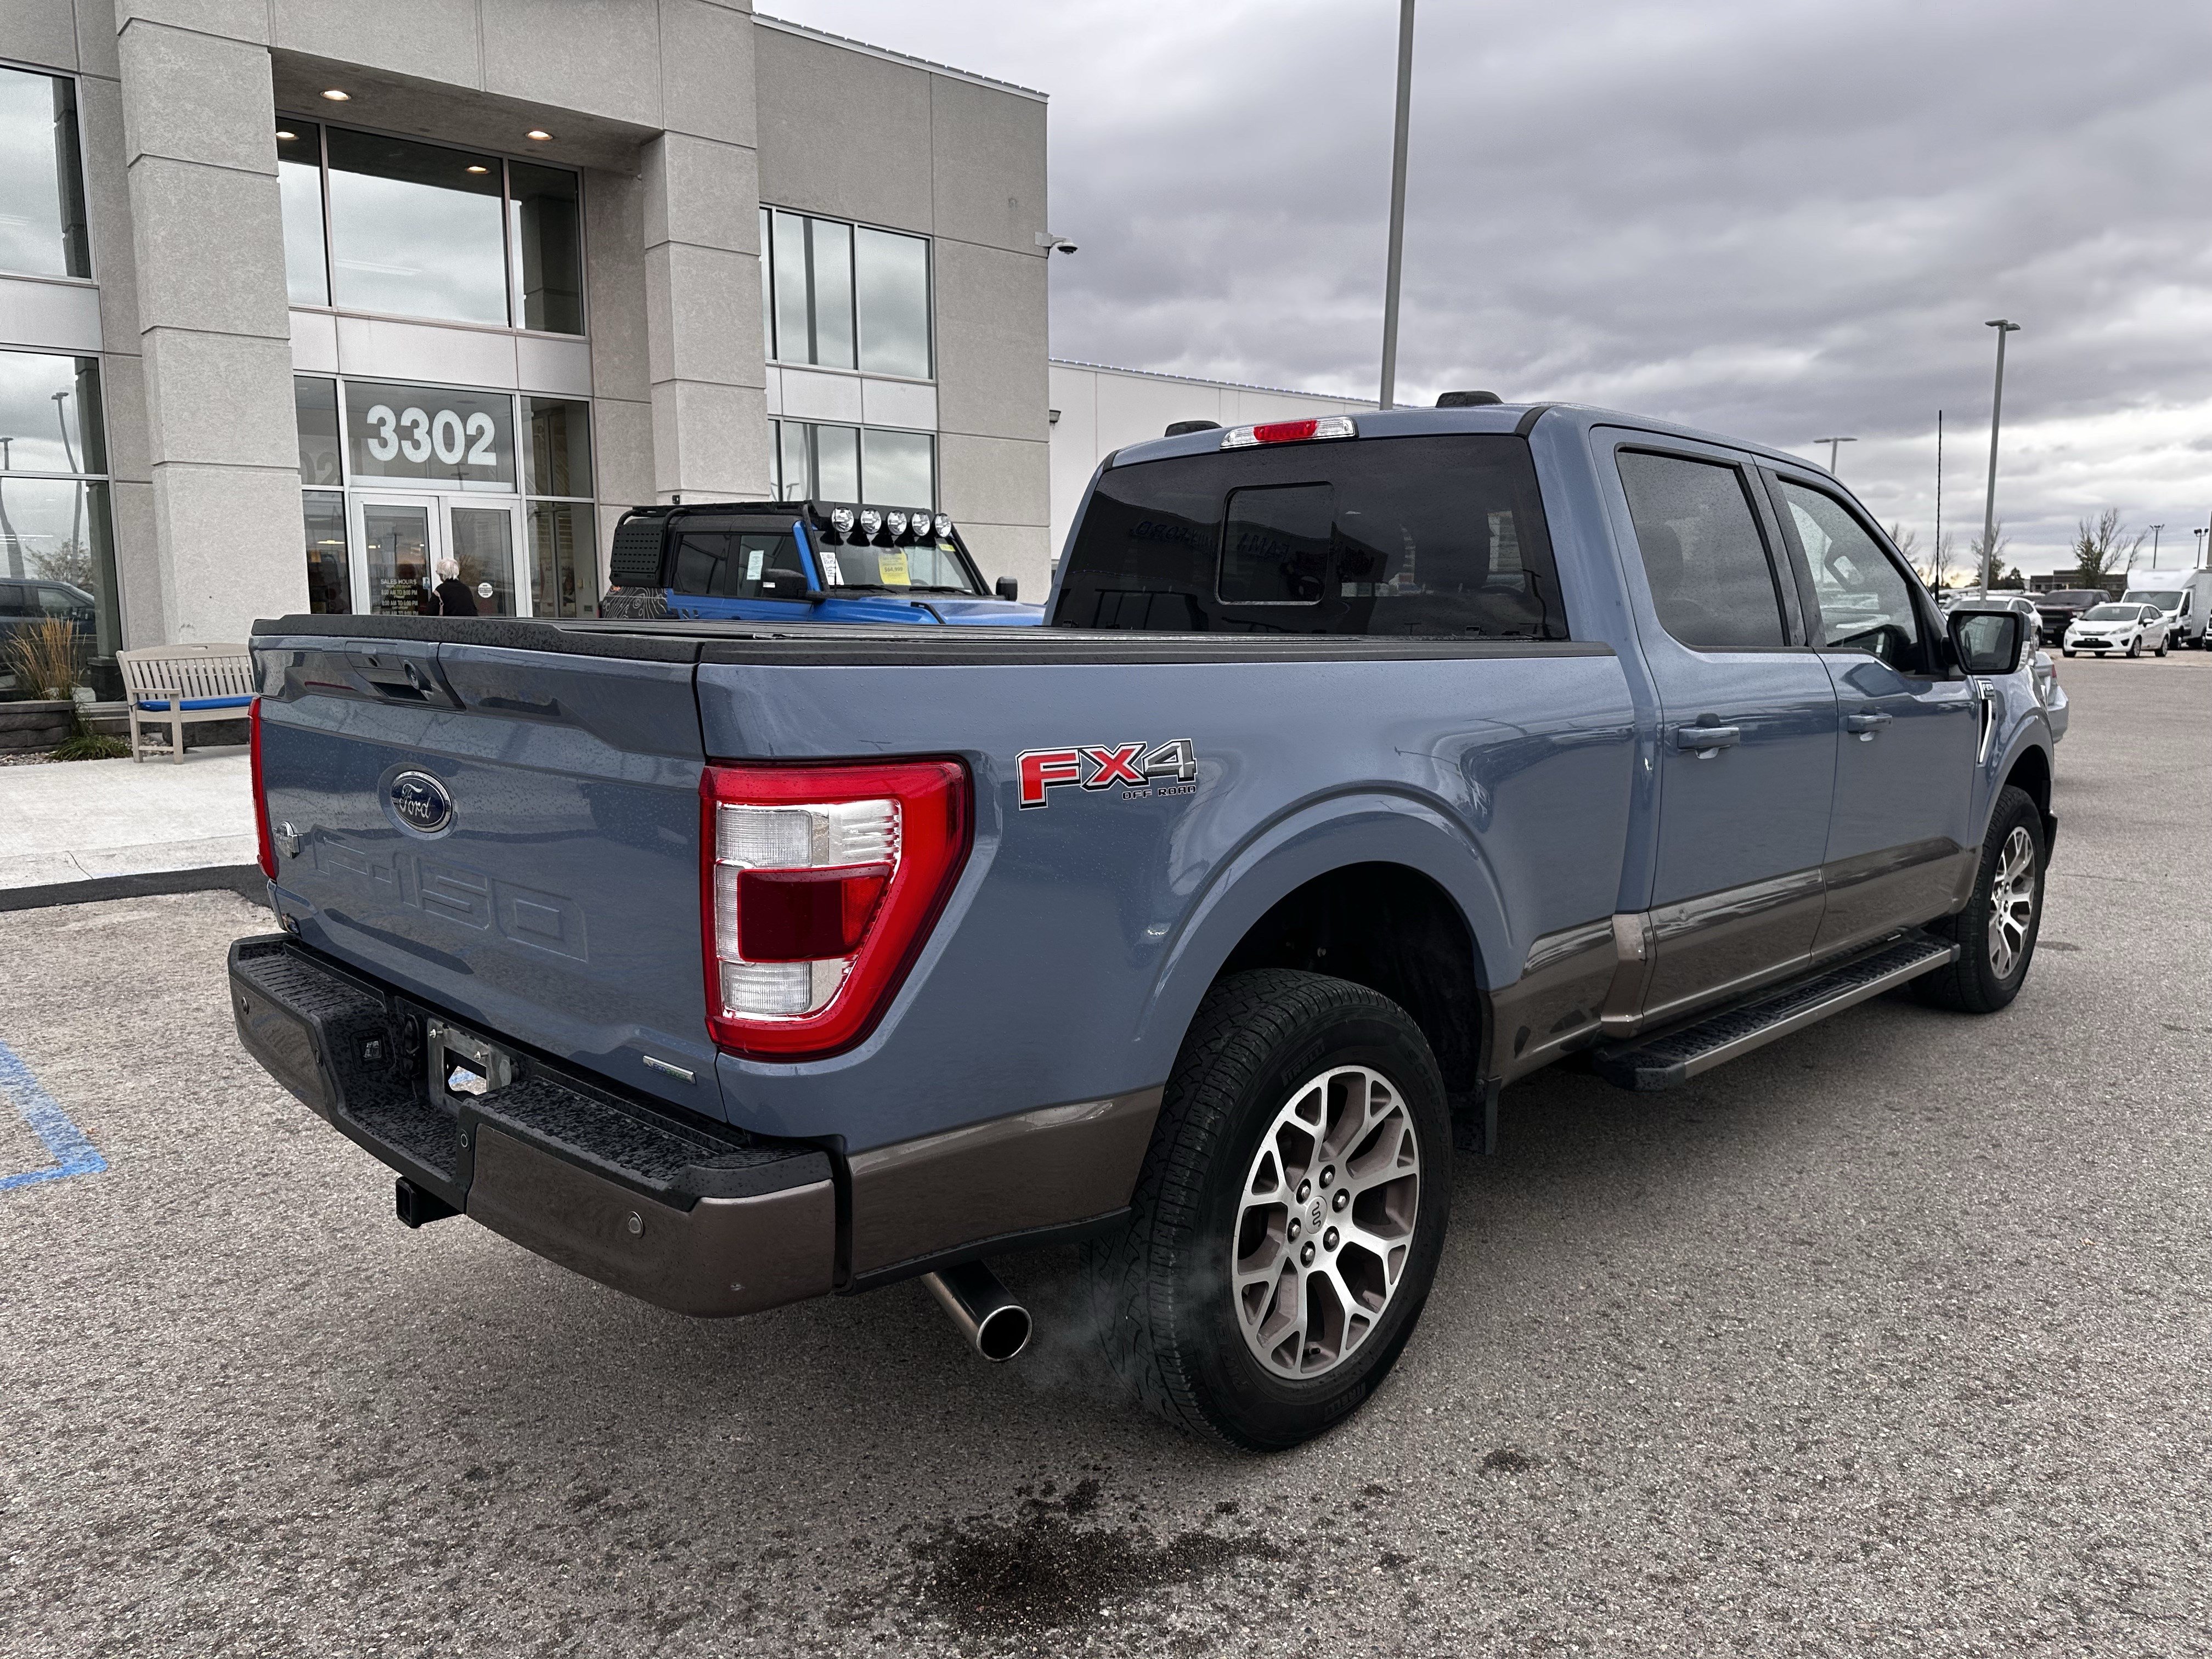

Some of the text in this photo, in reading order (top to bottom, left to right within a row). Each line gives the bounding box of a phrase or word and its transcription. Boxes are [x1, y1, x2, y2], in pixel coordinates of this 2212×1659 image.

[366, 405, 496, 466] 3302
[1015, 738, 1198, 811] FX4
[1121, 785, 1197, 800] OFF ROAD
[398, 783, 431, 820] Ford
[1280, 1037, 1325, 1087] PIRELLI
